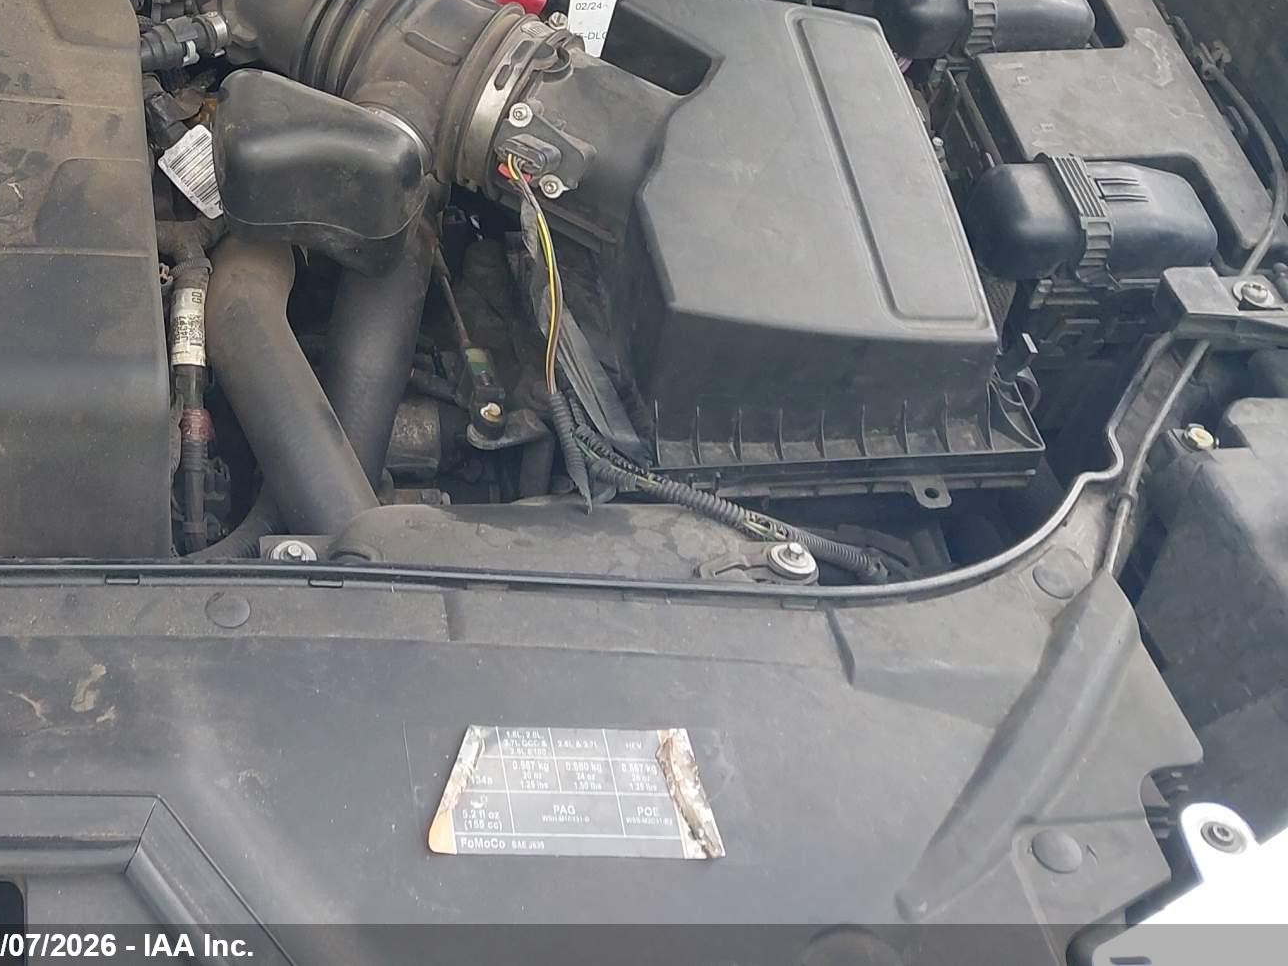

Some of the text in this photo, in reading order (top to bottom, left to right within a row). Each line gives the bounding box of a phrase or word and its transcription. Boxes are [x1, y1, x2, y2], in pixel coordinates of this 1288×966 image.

[575, 2, 602, 11] 02/24
[552, 804, 576, 815] PAG
[487, 811, 500, 820] oz
[487, 820, 503, 832] cc)
[460, 837, 506, 850] FoMoCo
